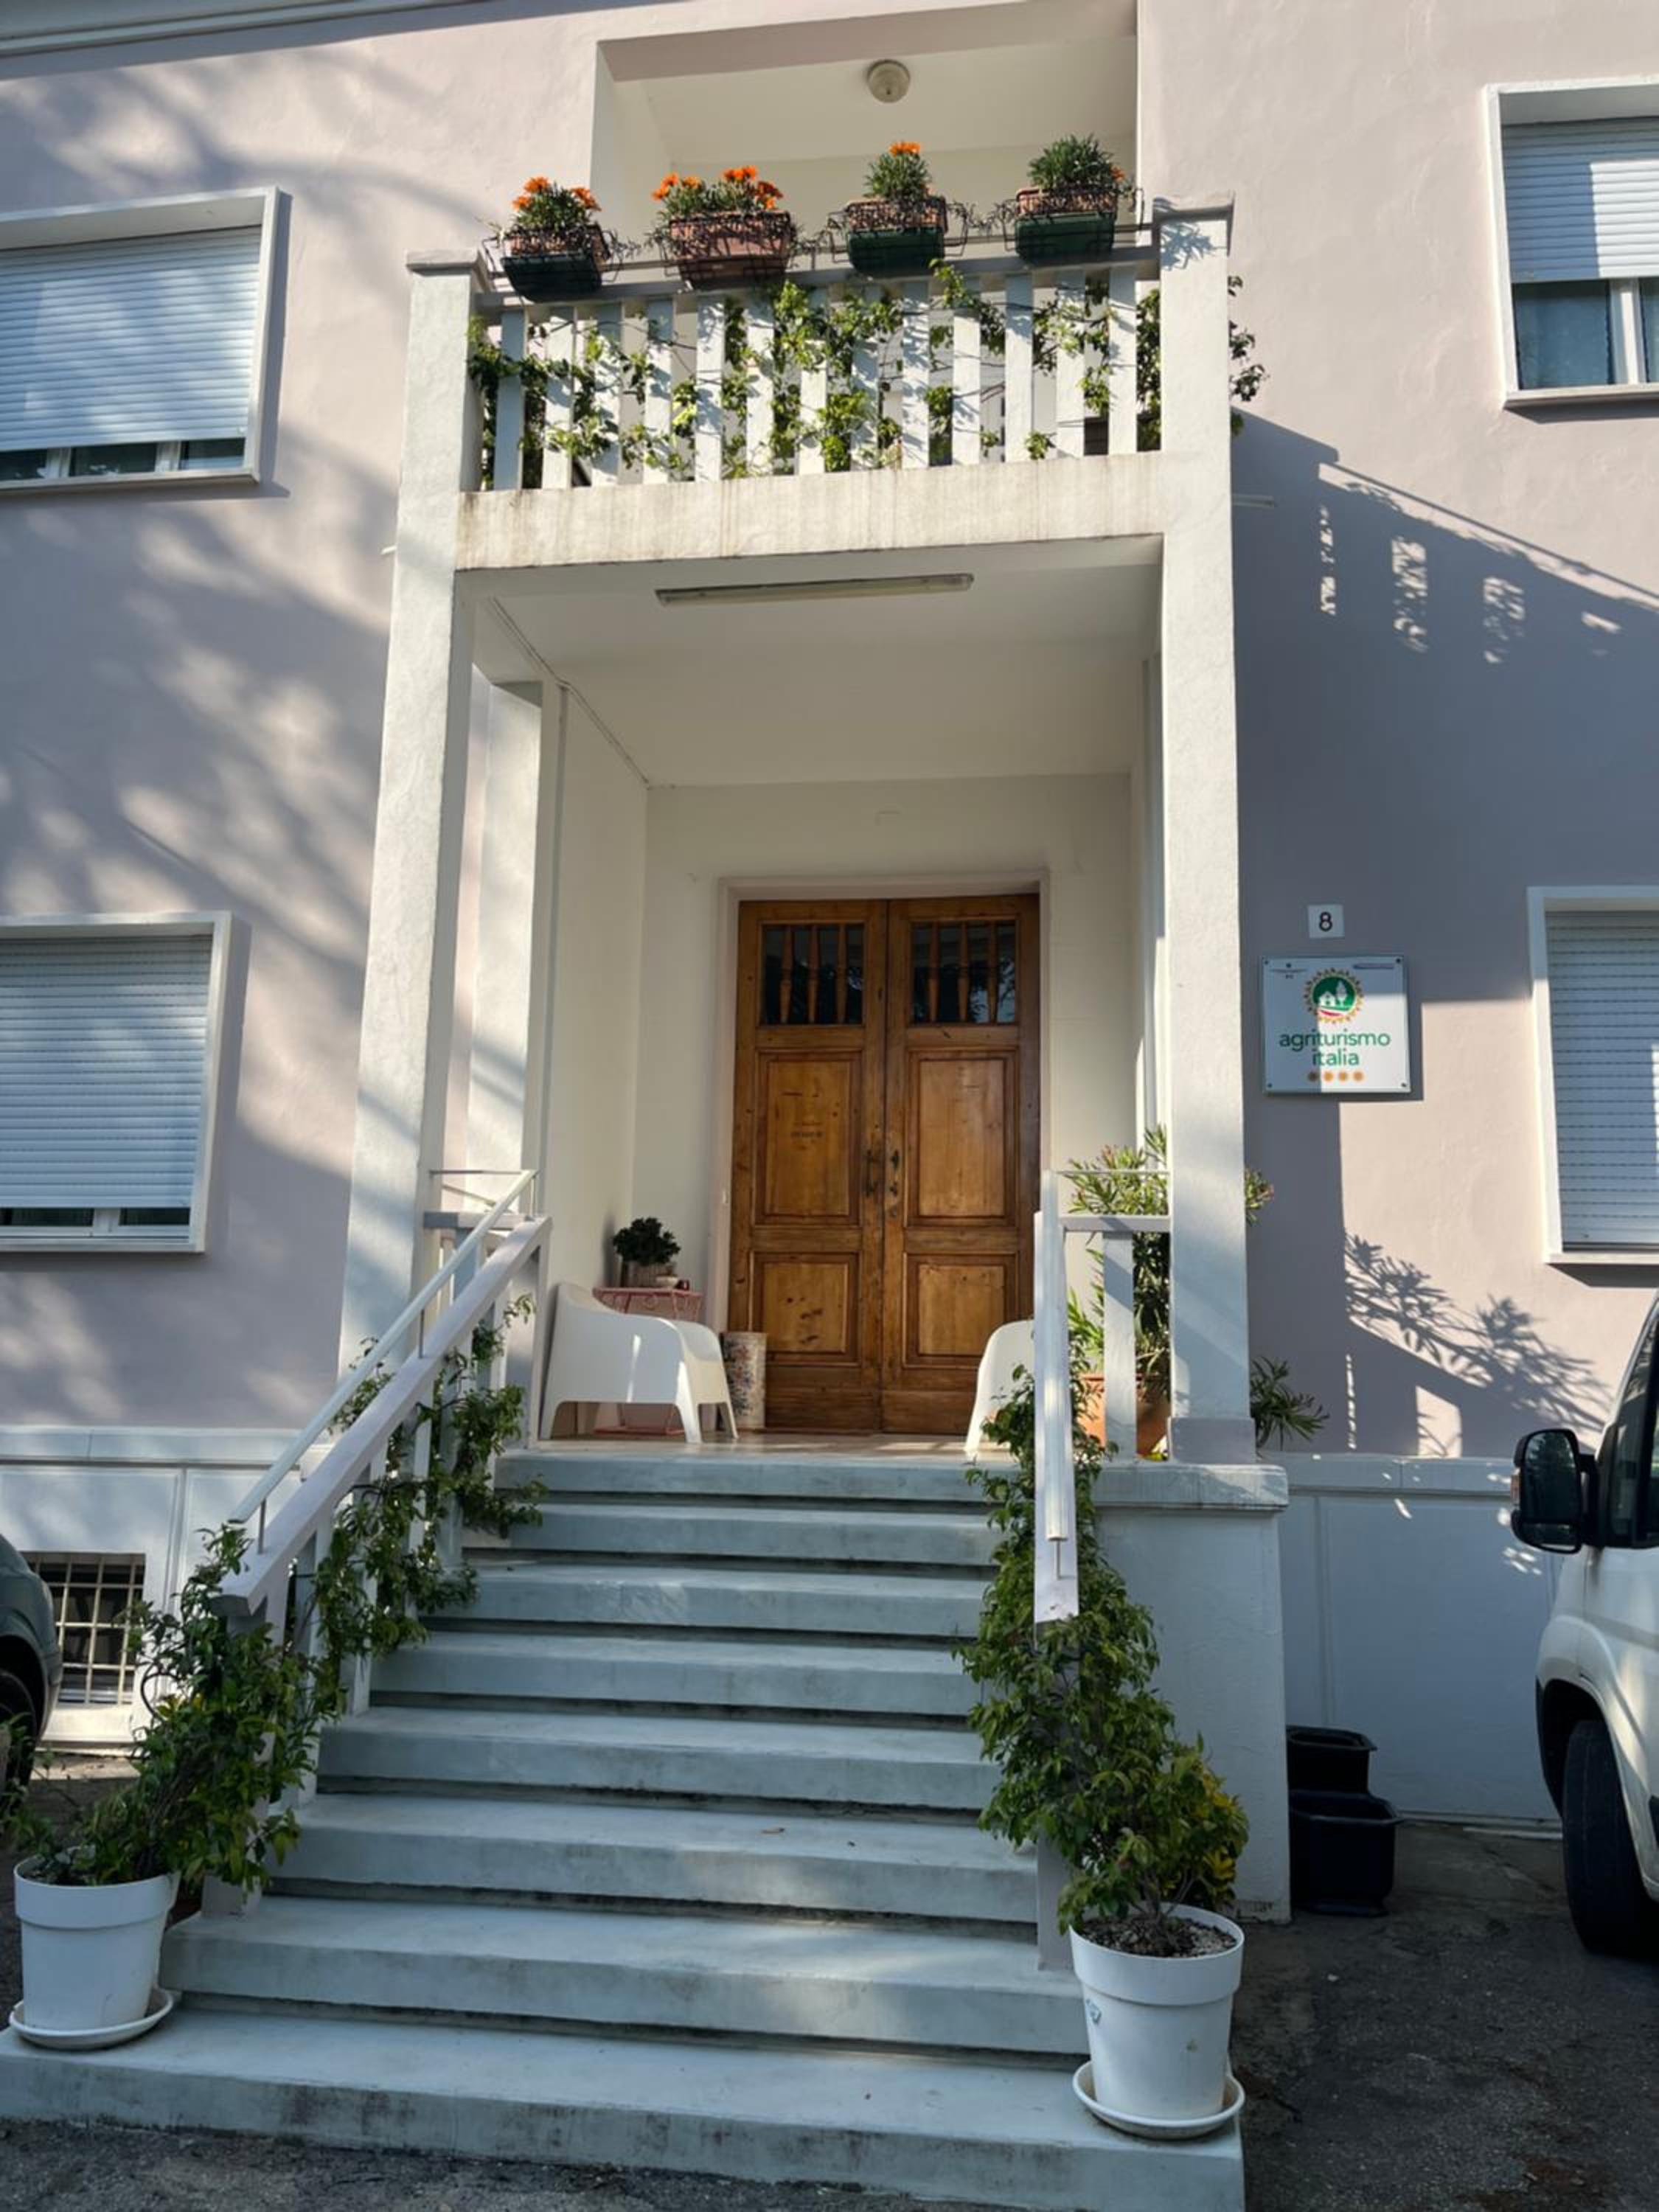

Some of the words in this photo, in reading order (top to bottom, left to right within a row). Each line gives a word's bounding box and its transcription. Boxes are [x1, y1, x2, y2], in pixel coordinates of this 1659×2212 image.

[1319, 911, 1332, 932] 8
[1279, 1029, 1391, 1051] agriturismo
[1312, 1048, 1360, 1065] italia
